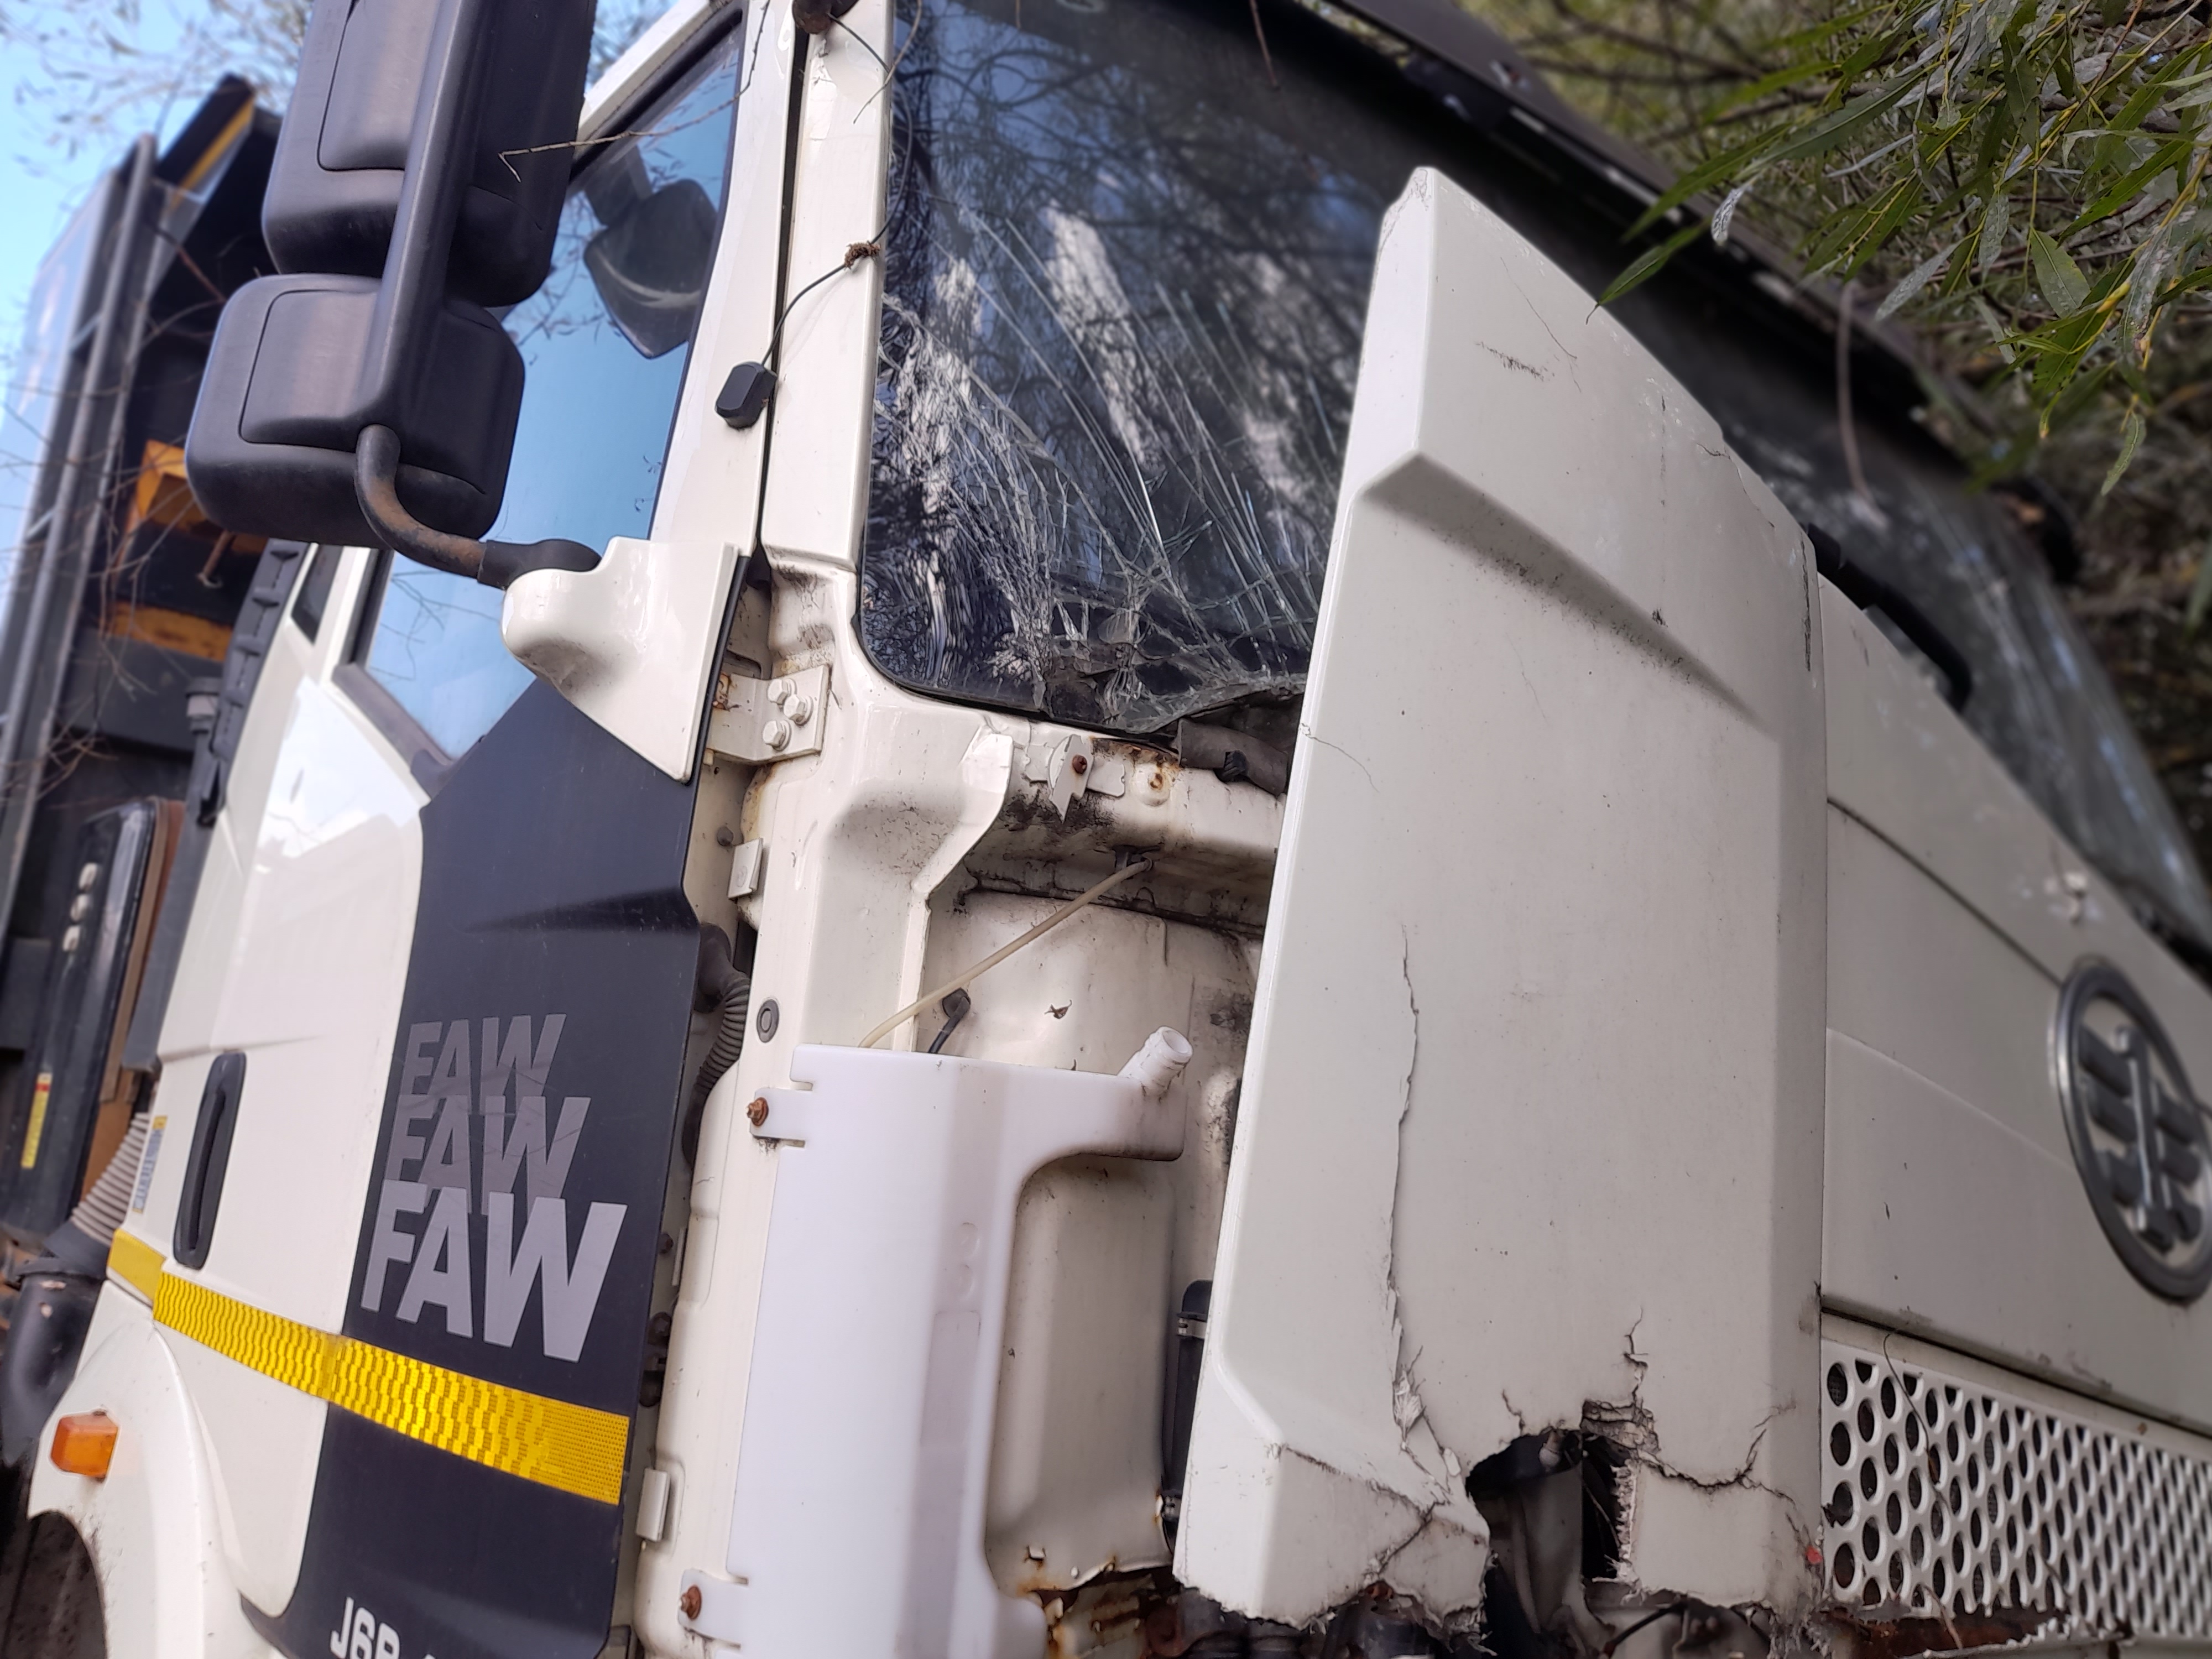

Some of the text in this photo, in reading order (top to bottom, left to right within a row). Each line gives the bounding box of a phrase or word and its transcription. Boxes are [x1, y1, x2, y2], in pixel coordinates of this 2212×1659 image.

[399, 1013, 567, 1116] FAW
[386, 1094, 591, 1215] FAW
[361, 1179, 628, 1363] FAW
